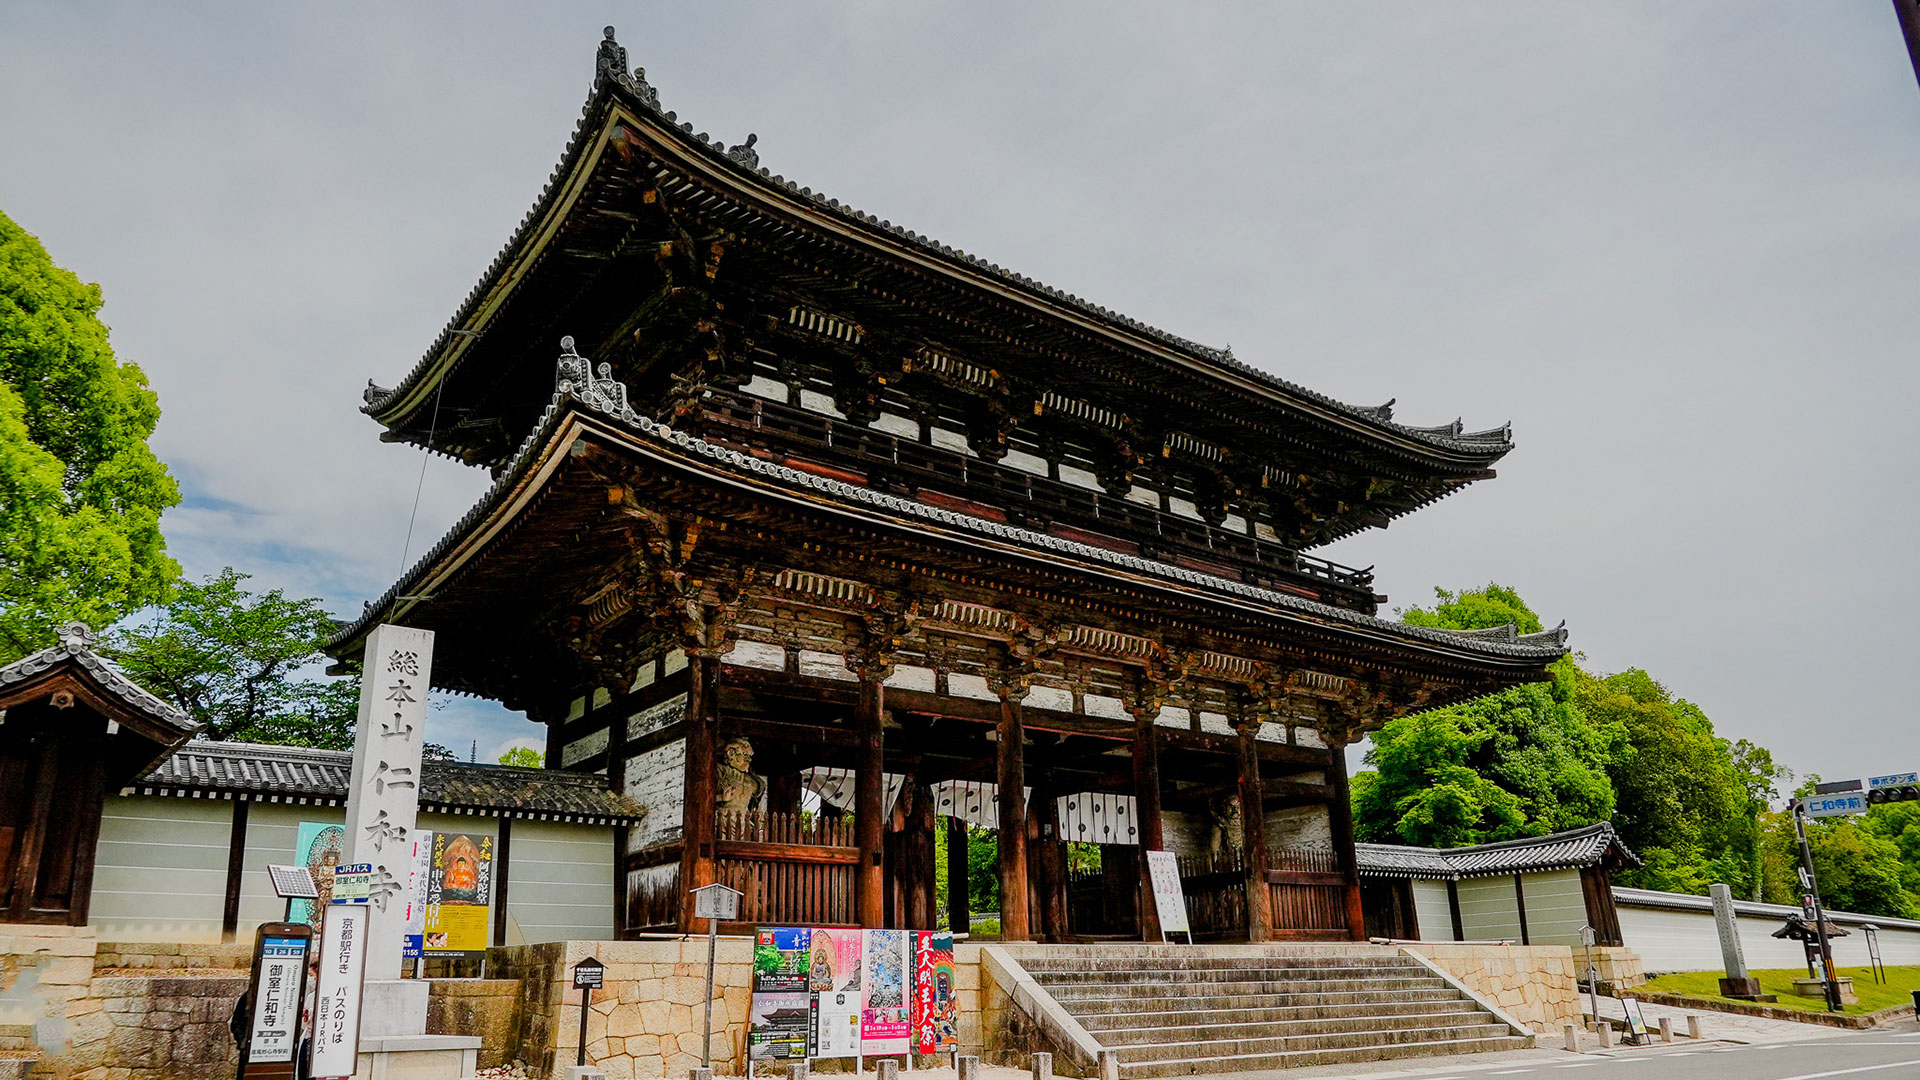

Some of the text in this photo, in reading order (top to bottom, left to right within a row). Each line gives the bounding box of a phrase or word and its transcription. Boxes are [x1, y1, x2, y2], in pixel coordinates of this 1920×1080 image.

[1871, 774, 1917, 786] 押ボタン式
[1809, 797, 1861, 812] 仁和寺前
[338, 864, 369, 873] JRバス
[335, 875, 369, 885] 御室仁和寺
[332, 918, 354, 1044] 京都駅行き バスのりば
[263, 964, 283, 1028] 御室仁和寺
[317, 996, 330, 1054] 西日本JRバス
